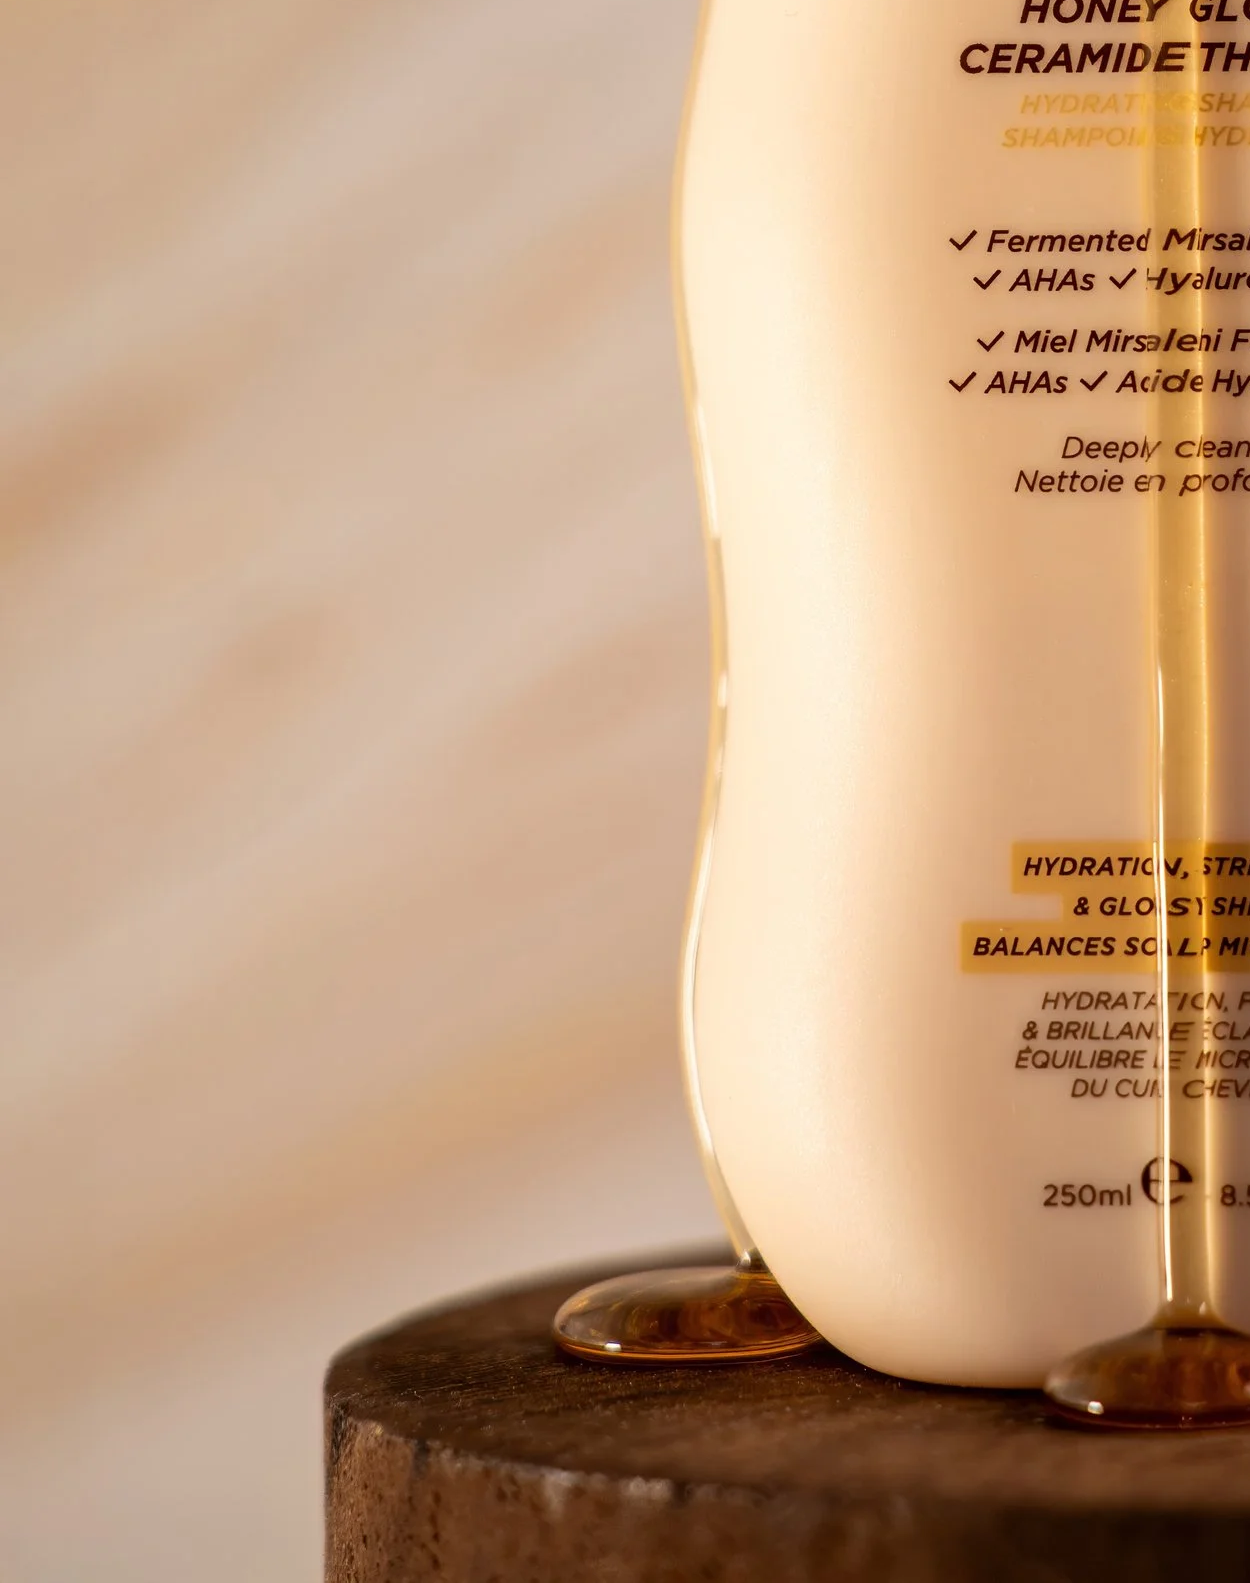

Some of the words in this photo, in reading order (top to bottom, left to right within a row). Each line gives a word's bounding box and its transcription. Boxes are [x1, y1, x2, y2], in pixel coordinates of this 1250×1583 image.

[959, 43, 1188, 74] CERAMIDE
[986, 229, 1151, 253] Fermented
[1009, 269, 1095, 293] AHAs
[1014, 330, 1076, 354] Miel
[1085, 328, 1222, 353] Mirsalehi
[984, 371, 1068, 395] AHAs
[1115, 369, 1204, 393] Acide
[1061, 436, 1162, 462] Deeply
[1014, 470, 1124, 493] Nettoie
[1134, 474, 1166, 493] en
[1073, 897, 1090, 916] &
[973, 937, 1116, 956] BALANCES
[1022, 1021, 1038, 1040] &
[1046, 1021, 1194, 1041] BRILLANE
[1015, 1046, 1147, 1069] ÉQUILIBRE
[1071, 1079, 1108, 1098] DU
[1043, 1184, 1132, 1207] 250ml
